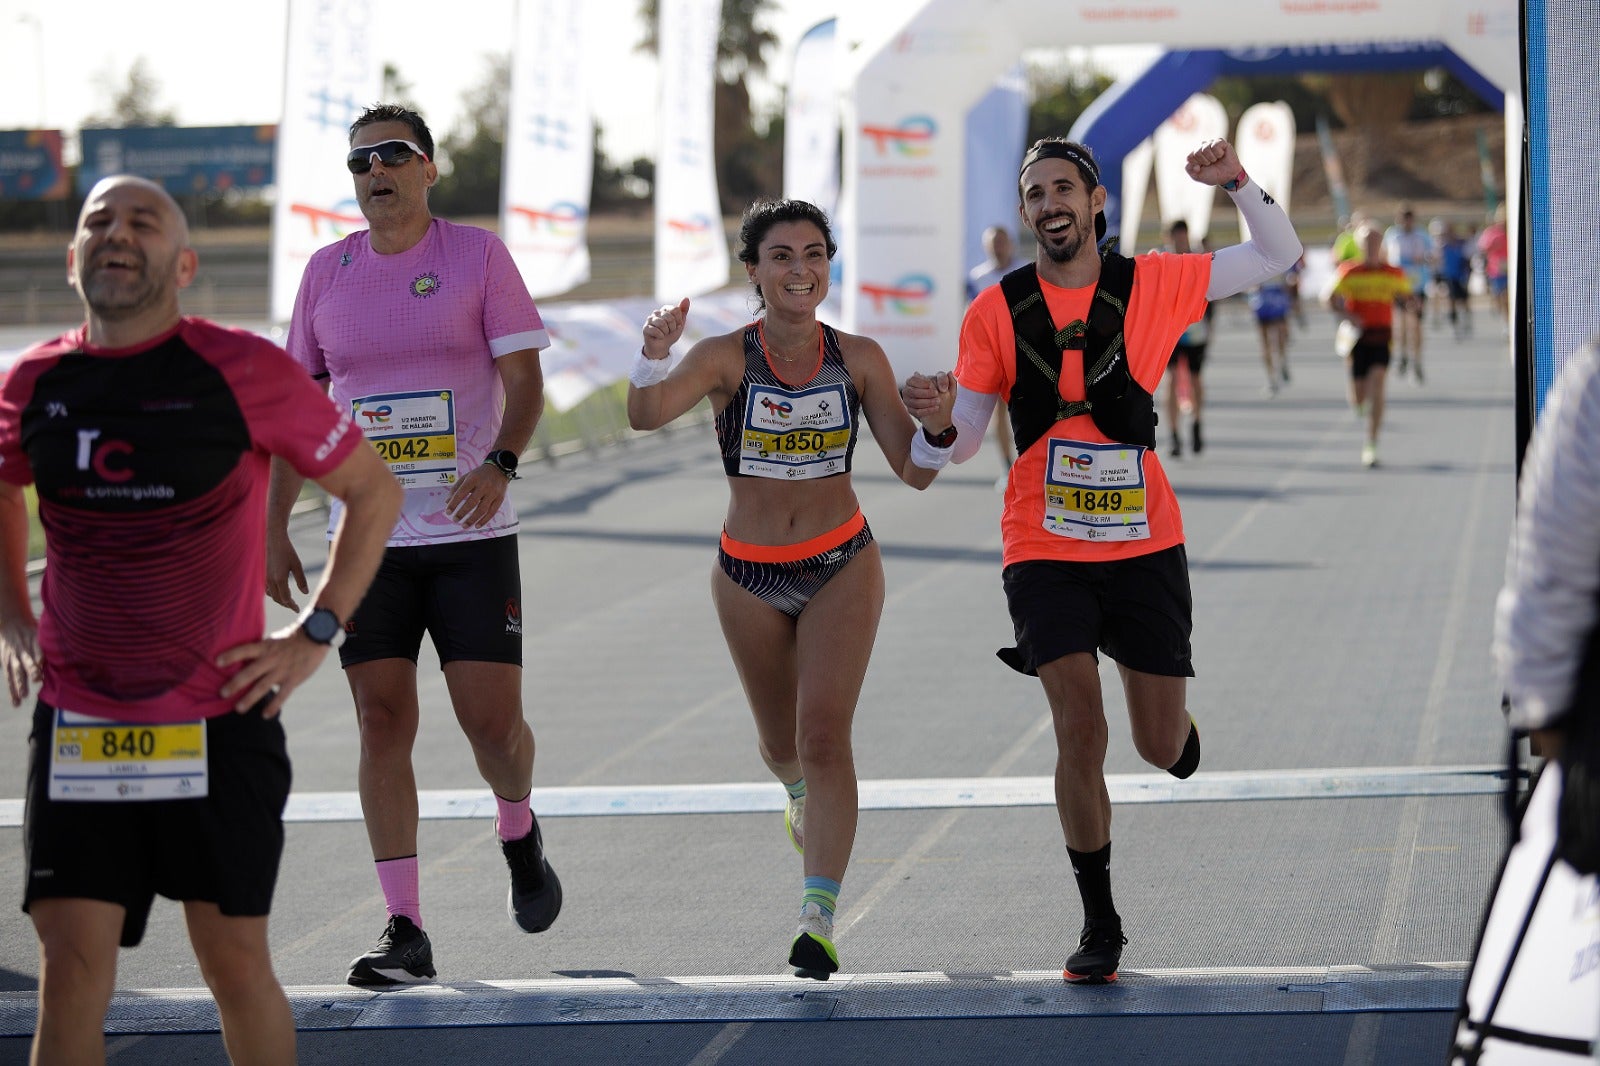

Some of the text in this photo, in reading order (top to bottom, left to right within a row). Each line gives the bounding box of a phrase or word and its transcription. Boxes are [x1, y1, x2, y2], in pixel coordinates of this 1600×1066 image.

[376, 438, 430, 460] 2042
[771, 432, 824, 451] 1850
[1072, 490, 1122, 511] 1849
[102, 729, 155, 758] 840
